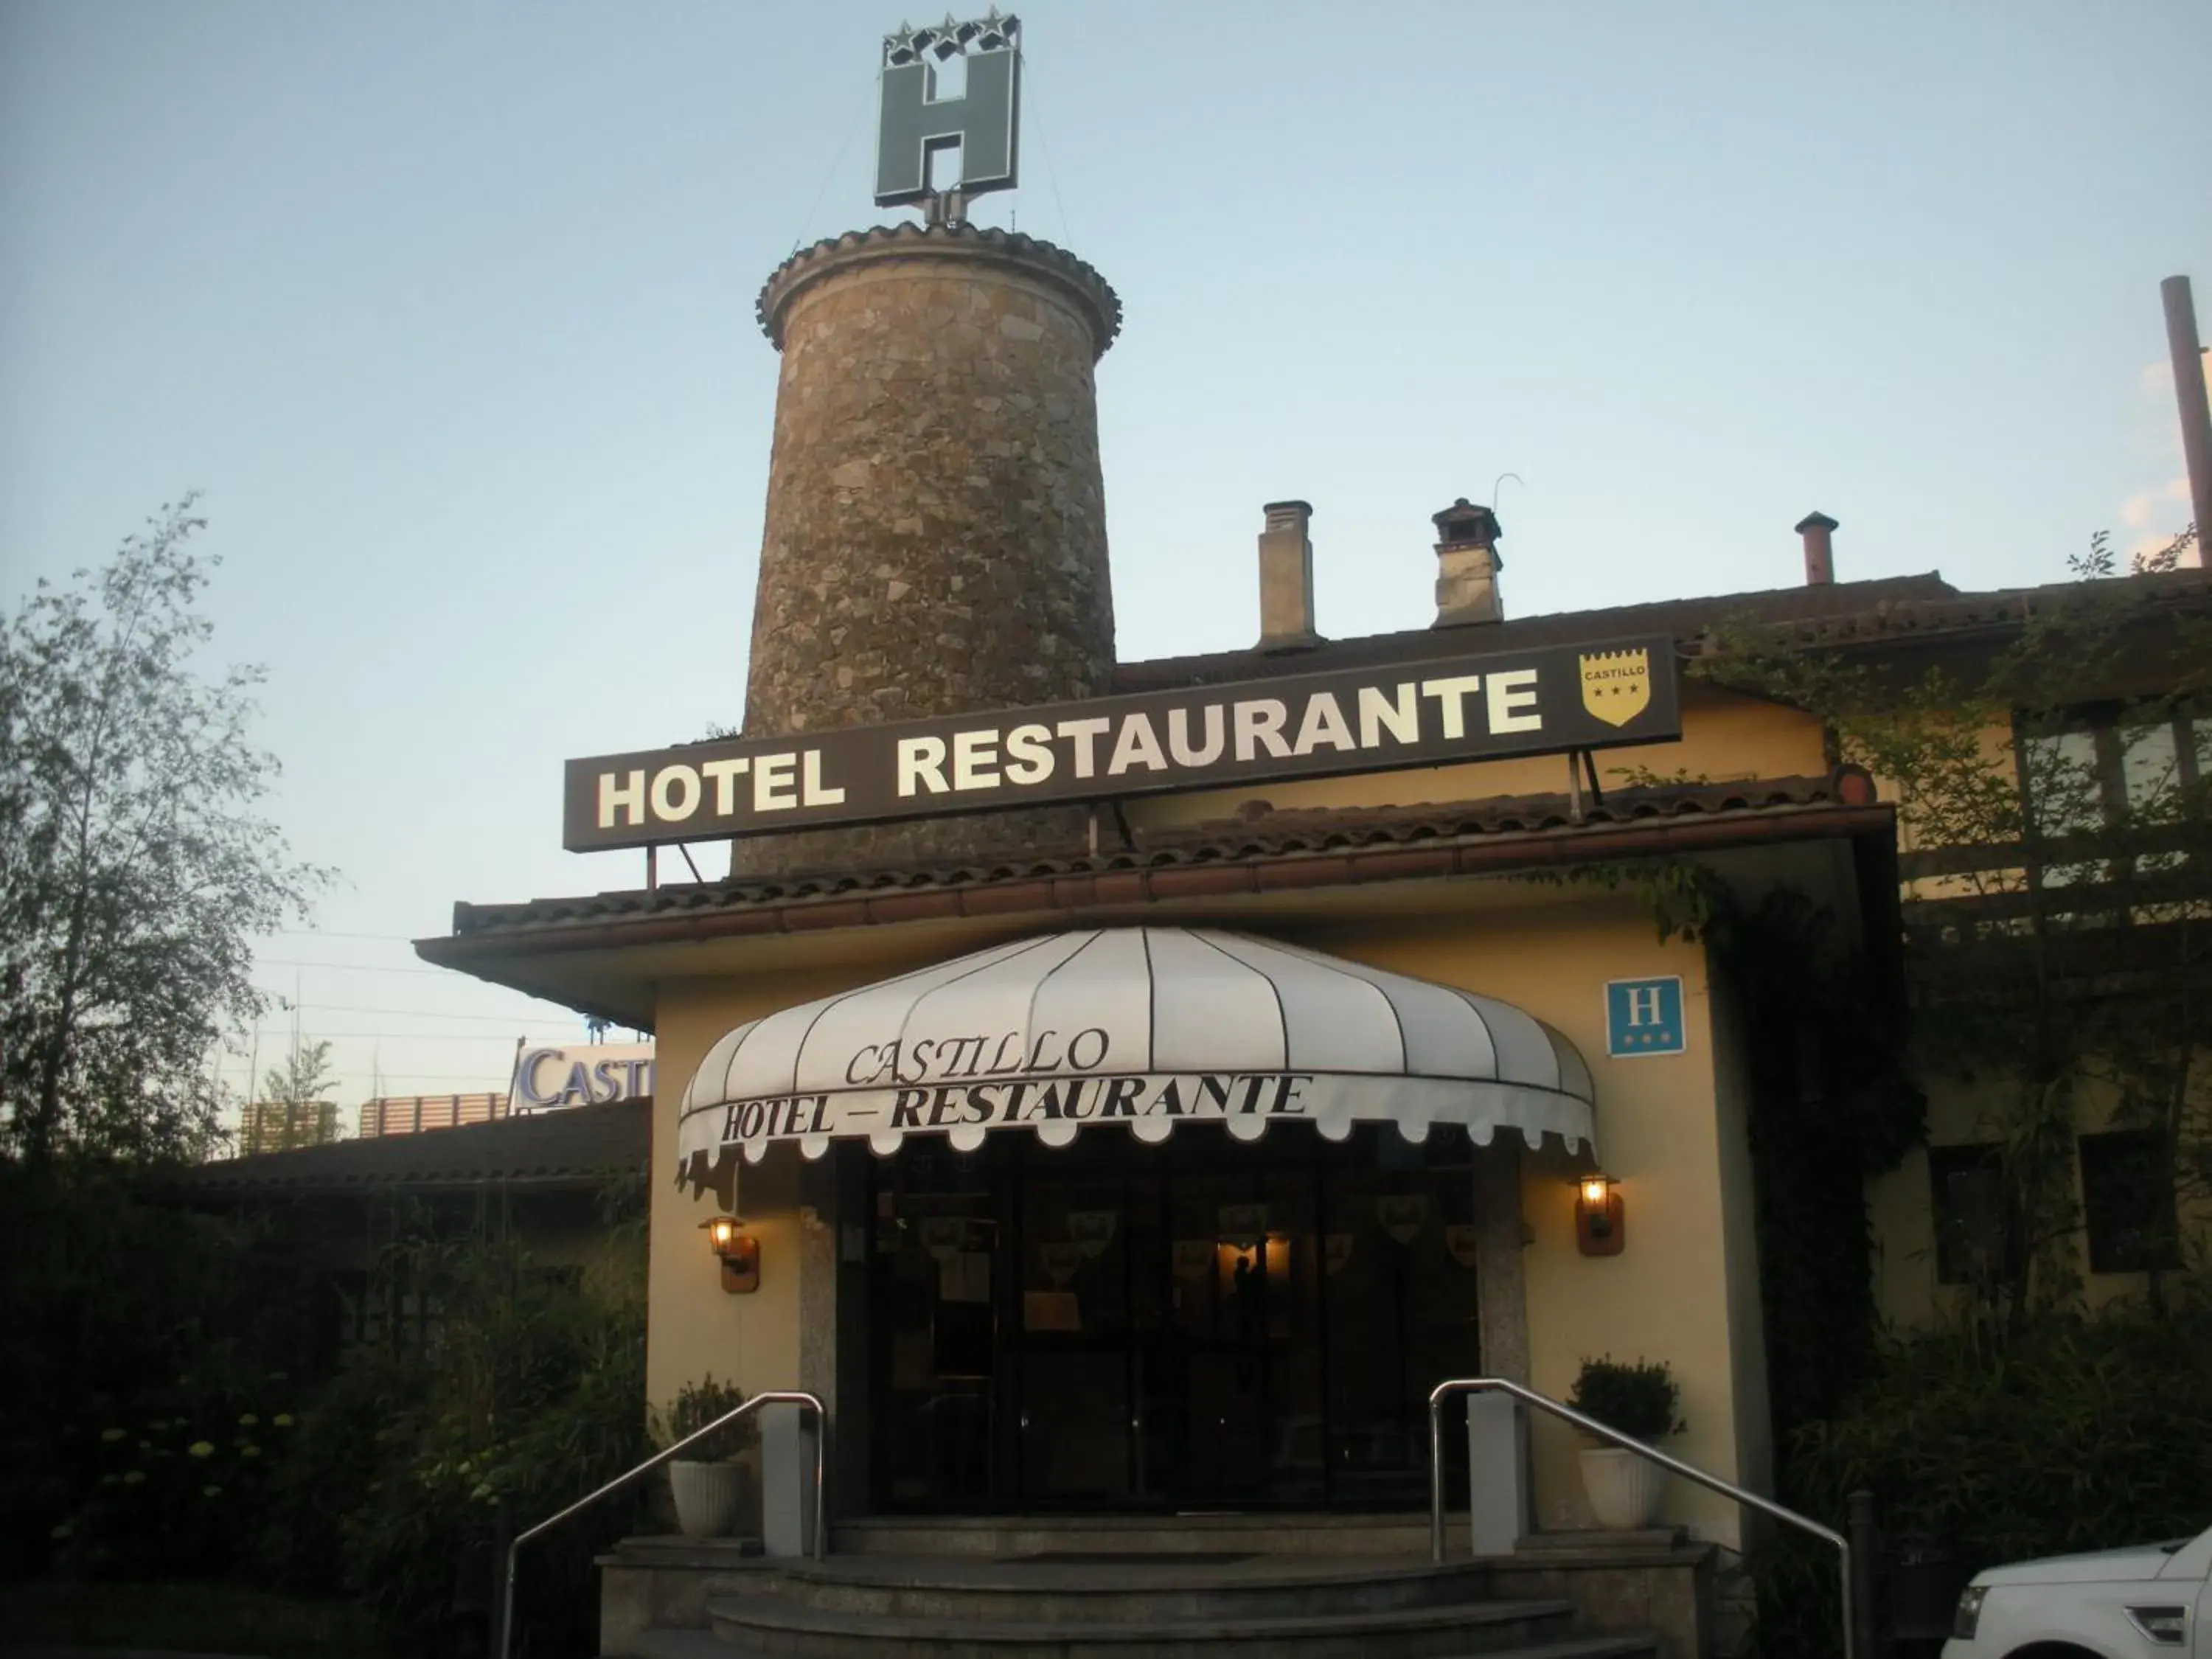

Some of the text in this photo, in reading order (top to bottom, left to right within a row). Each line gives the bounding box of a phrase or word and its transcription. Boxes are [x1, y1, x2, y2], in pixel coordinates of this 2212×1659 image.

[874, 47, 1020, 207] H
[1585, 665, 1645, 681] CASTILLO
[598, 668, 1543, 829] HOTEL RESTAURANTE
[1626, 986, 1664, 1026] H
[845, 1028, 1110, 1085] CASTILLO
[722, 1094, 835, 1141] HOTEL
[890, 1073, 1314, 1129] RESTAURANTE
